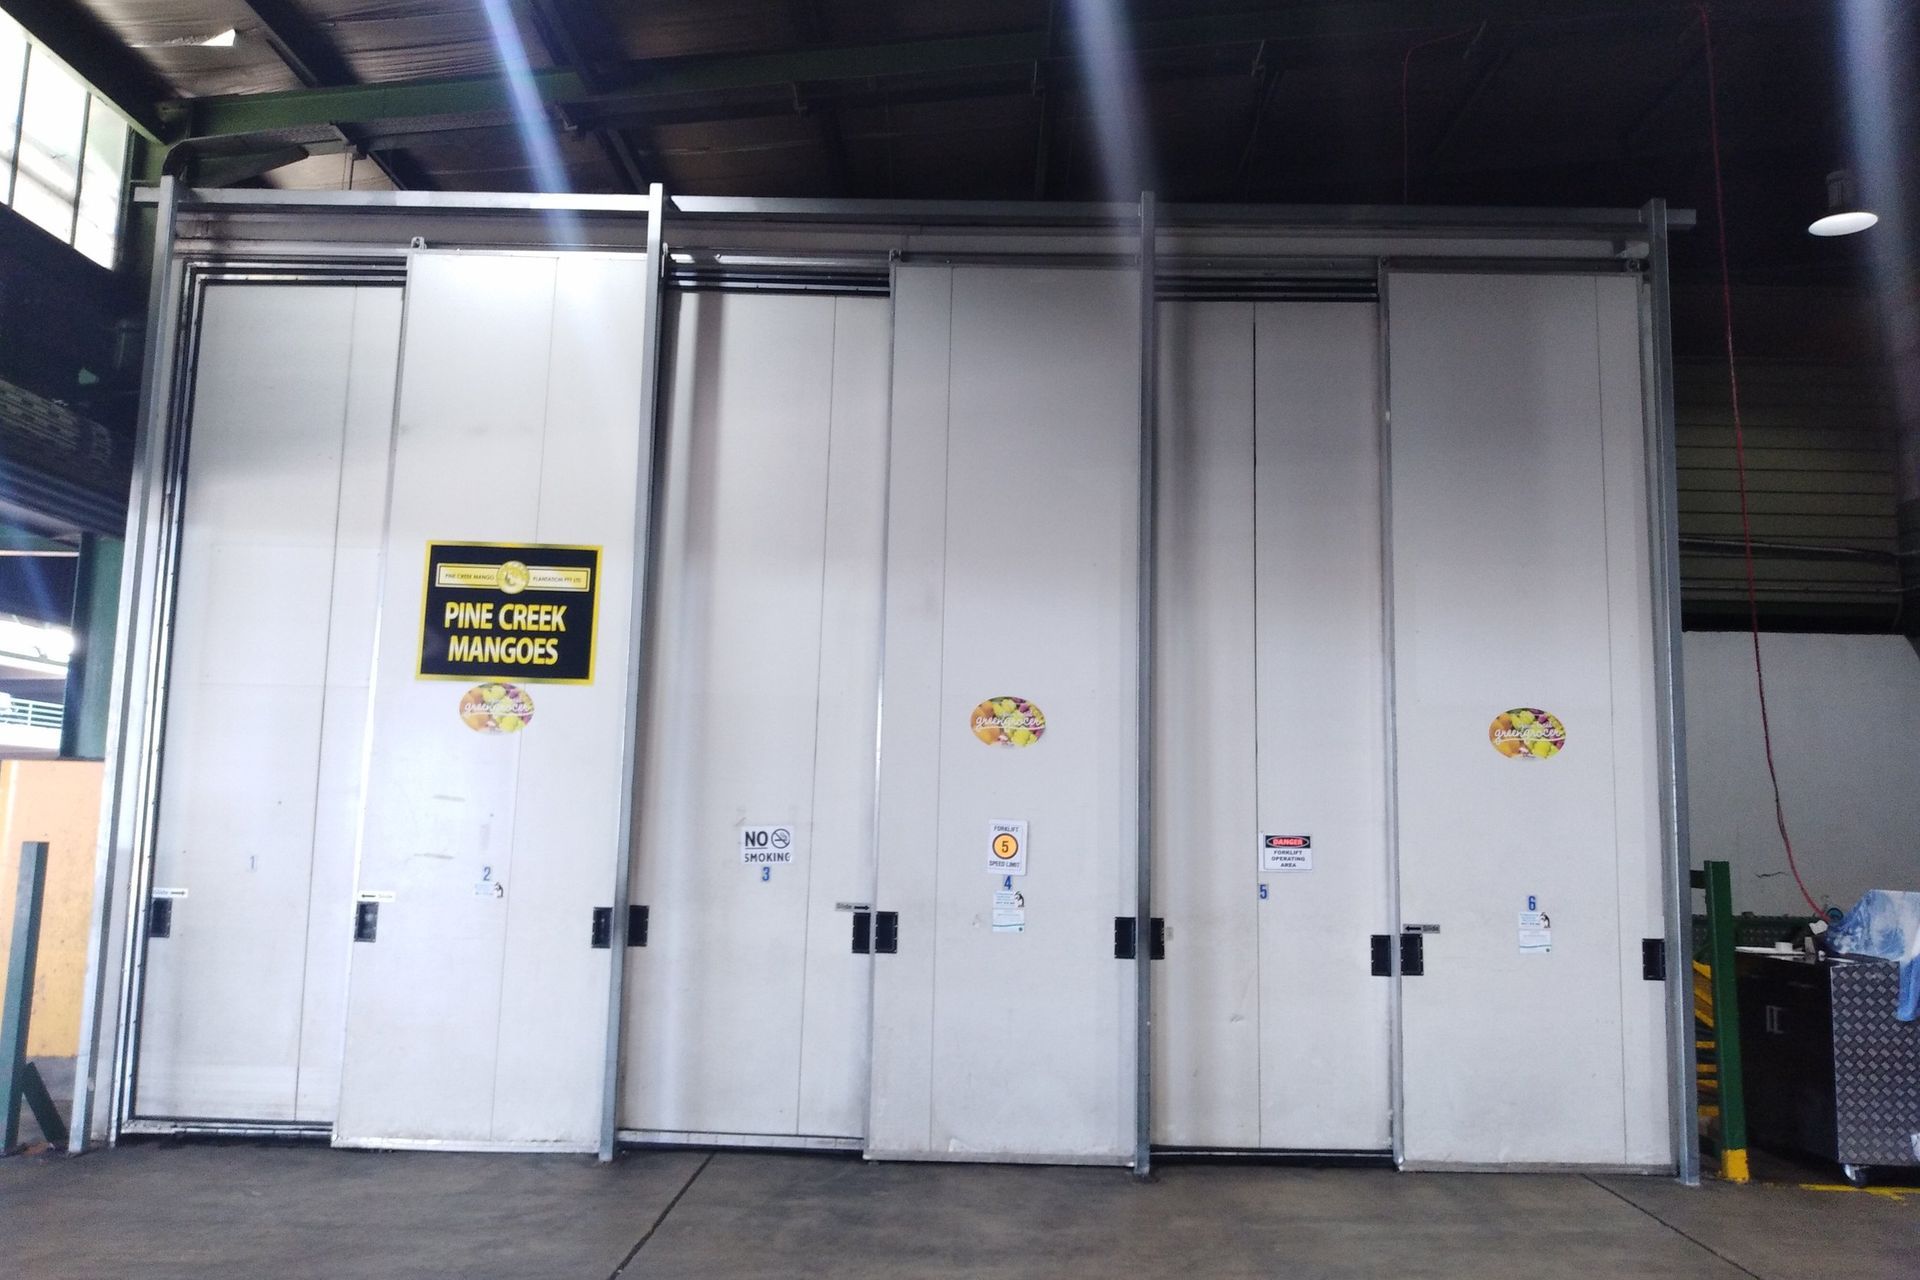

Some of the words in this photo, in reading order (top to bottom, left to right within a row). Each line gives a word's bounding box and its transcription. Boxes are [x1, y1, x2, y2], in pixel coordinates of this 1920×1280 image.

[444, 601, 494, 630] PINE
[498, 603, 568, 632] CREEK
[448, 635, 559, 665] MANGOES
[745, 831, 769, 847] NO
[1001, 840, 1009, 853] 5
[744, 852, 792, 863] SMOKING
[483, 866, 491, 881] 2
[762, 866, 770, 881] 3
[1004, 875, 1012, 890] 4
[1259, 884, 1268, 899] 5
[1528, 895, 1536, 911] 6
